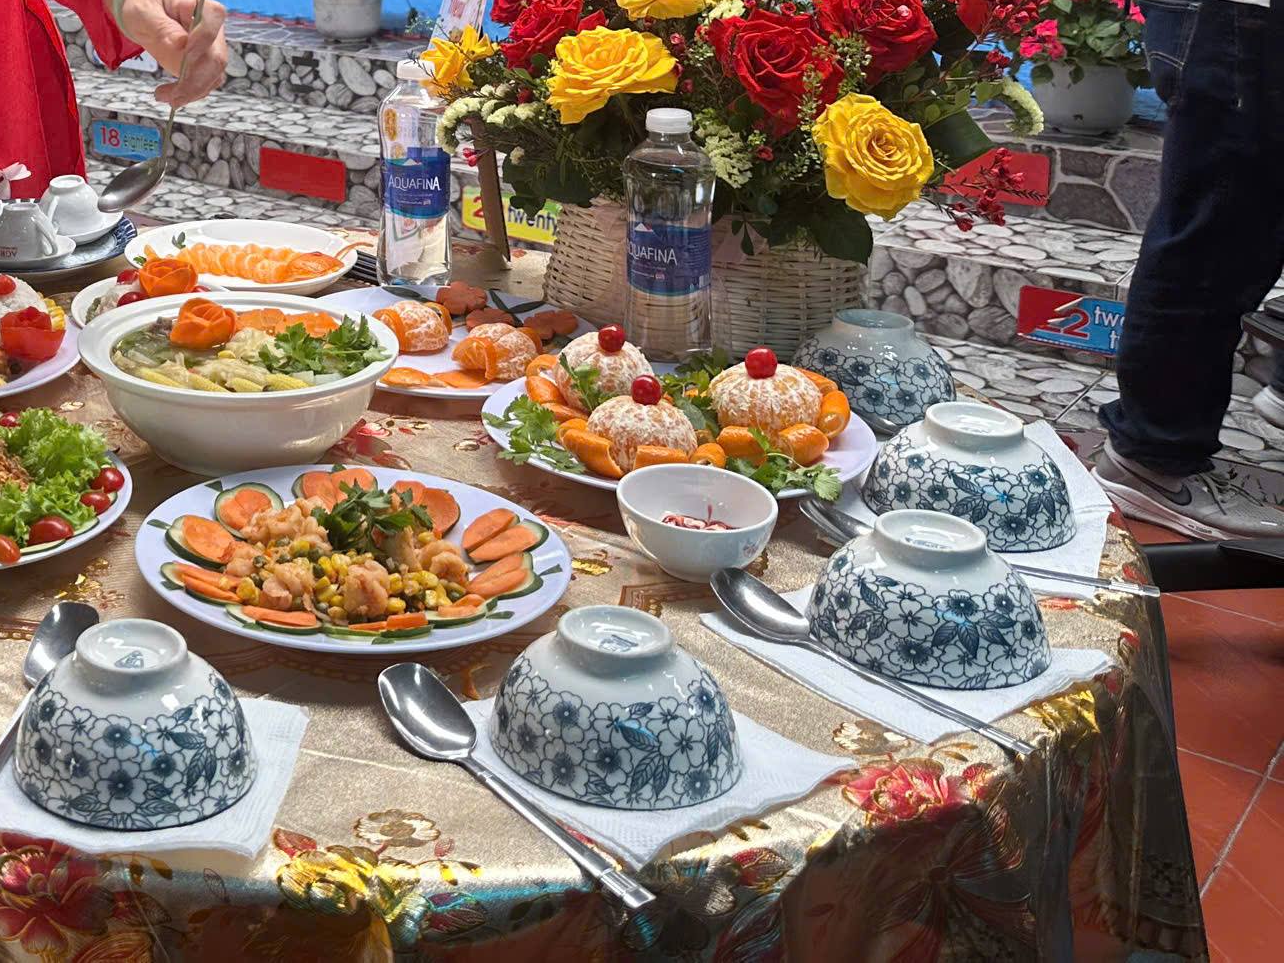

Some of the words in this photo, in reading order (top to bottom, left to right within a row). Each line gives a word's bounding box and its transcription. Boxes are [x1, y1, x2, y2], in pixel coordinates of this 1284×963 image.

[100, 125, 121, 148] 18
[387, 174, 442, 191] AQUAFINA
[508, 206, 557, 236] twnty
